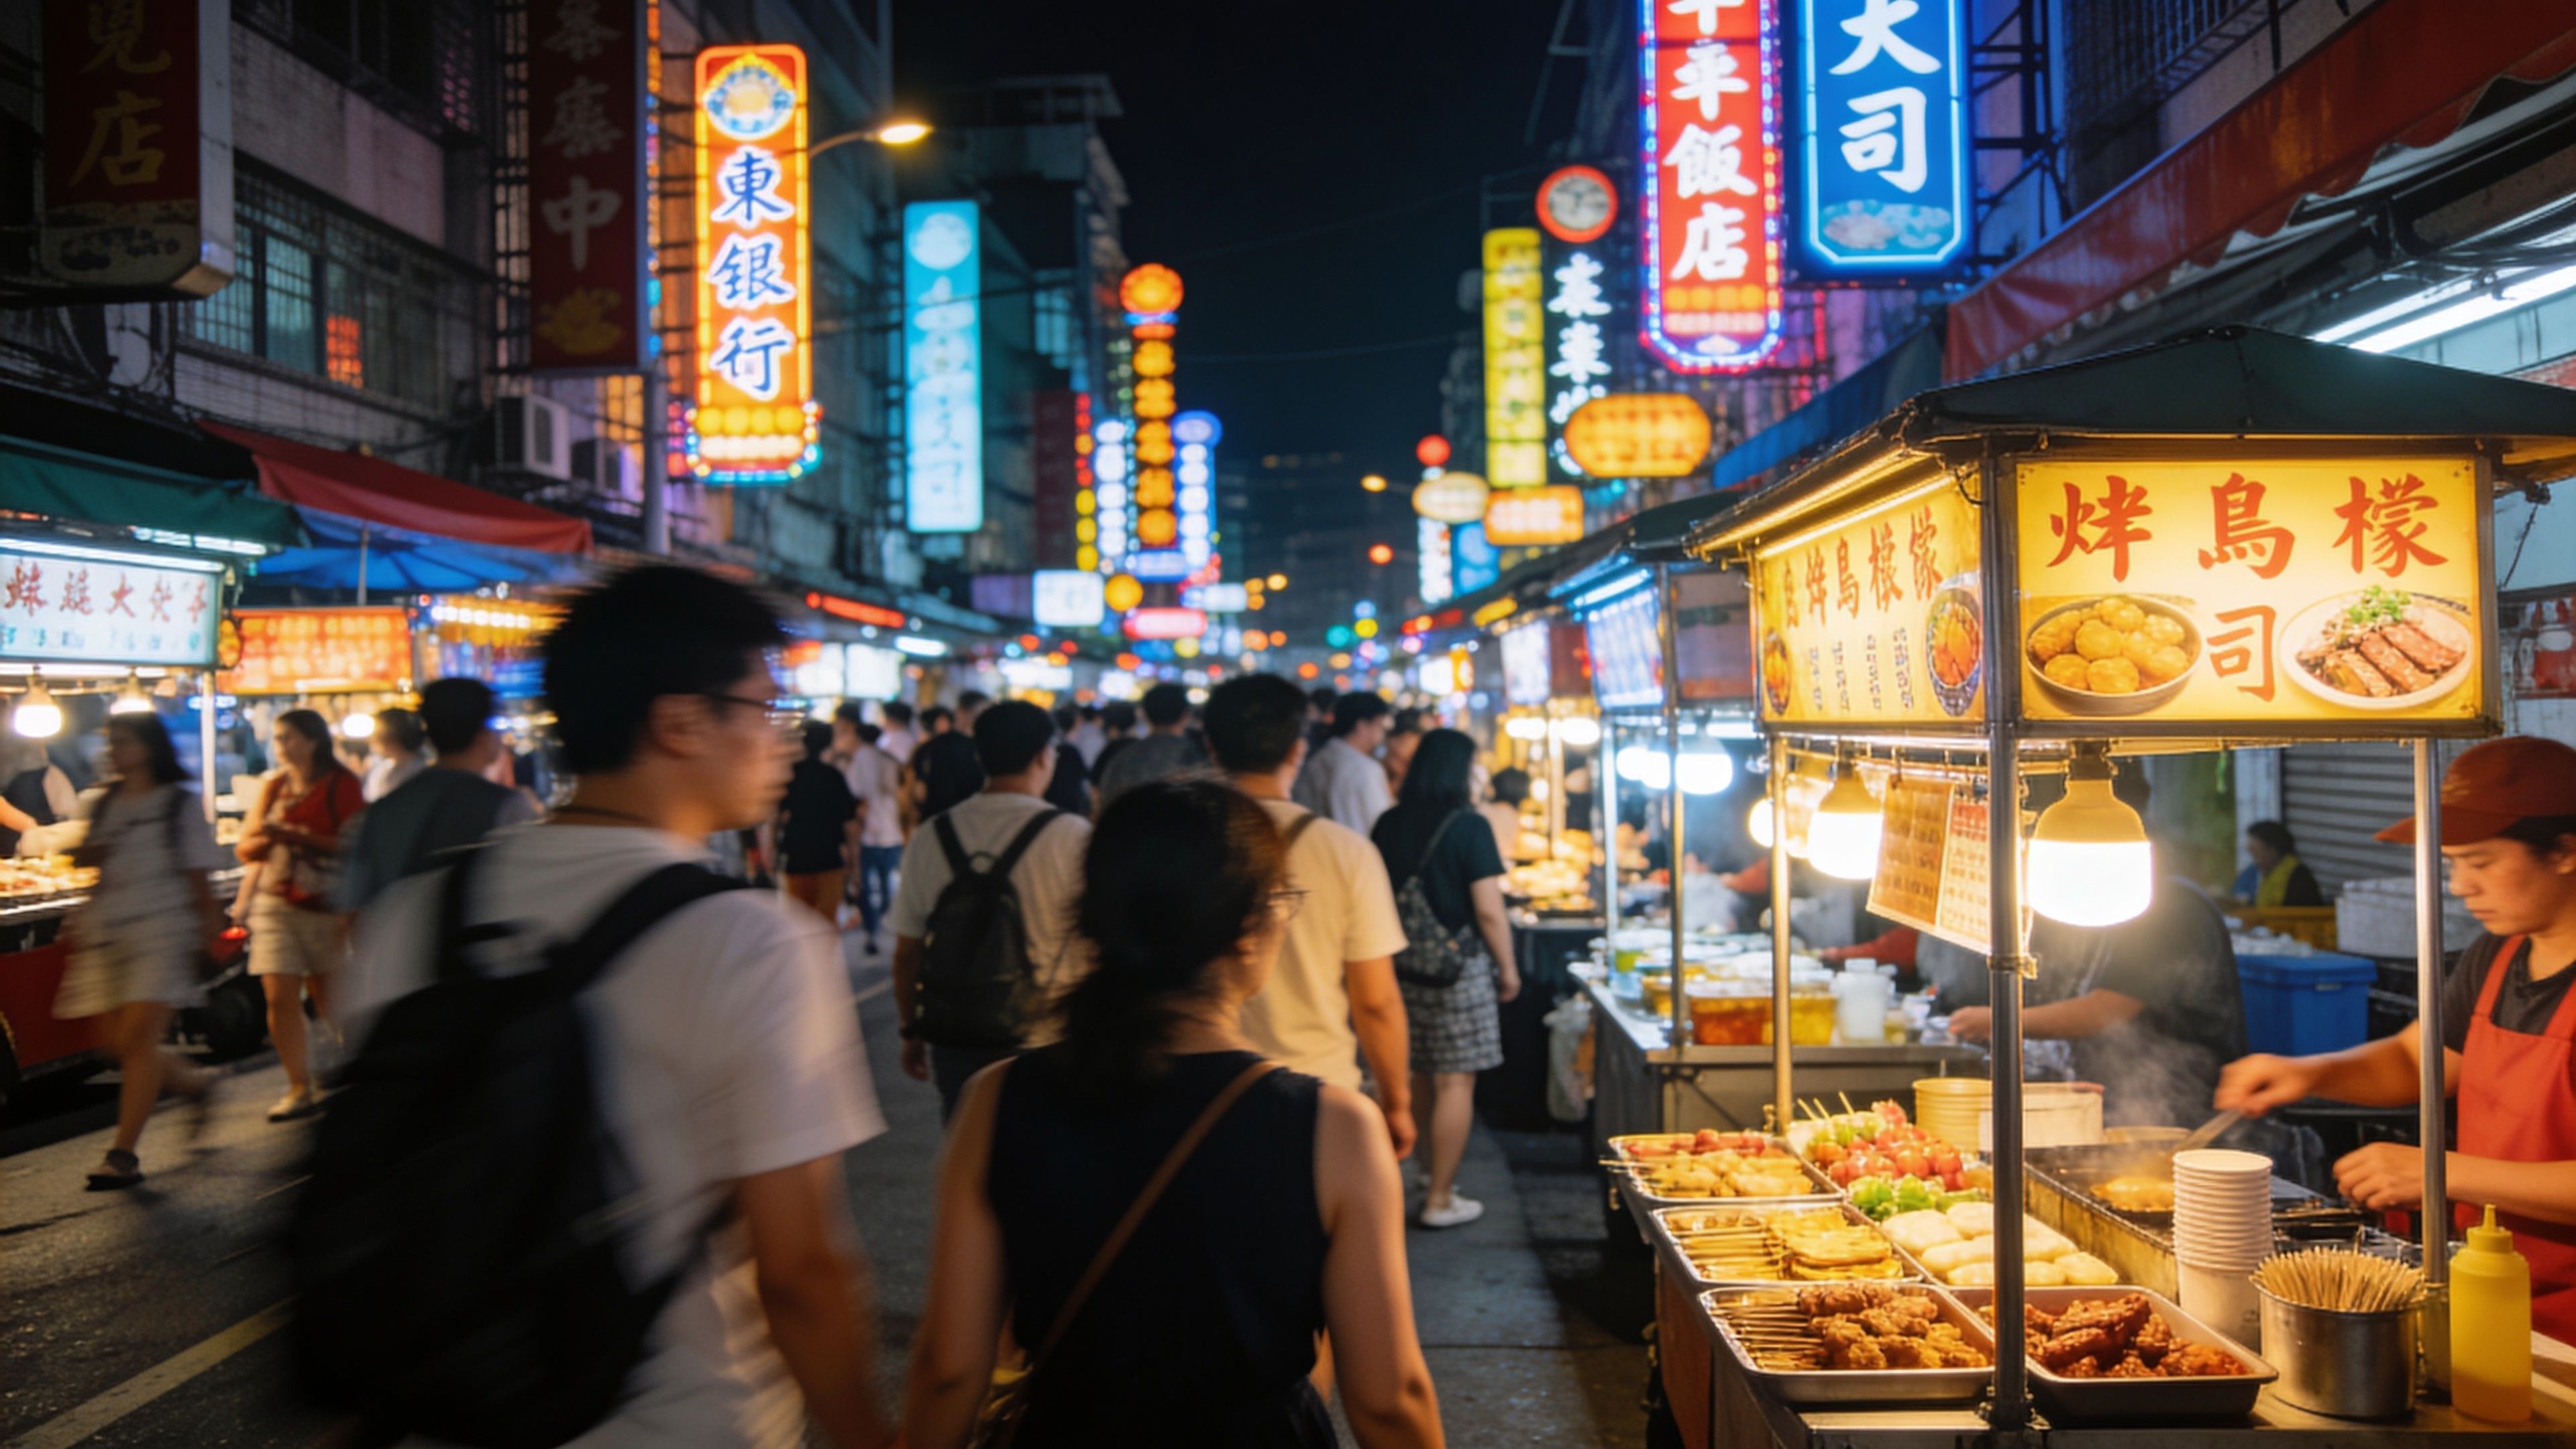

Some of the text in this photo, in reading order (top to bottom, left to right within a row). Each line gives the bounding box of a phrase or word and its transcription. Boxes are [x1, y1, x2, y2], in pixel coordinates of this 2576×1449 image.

[711, 146, 796, 399] 東銀行
[2206, 604, 2277, 702] 司
